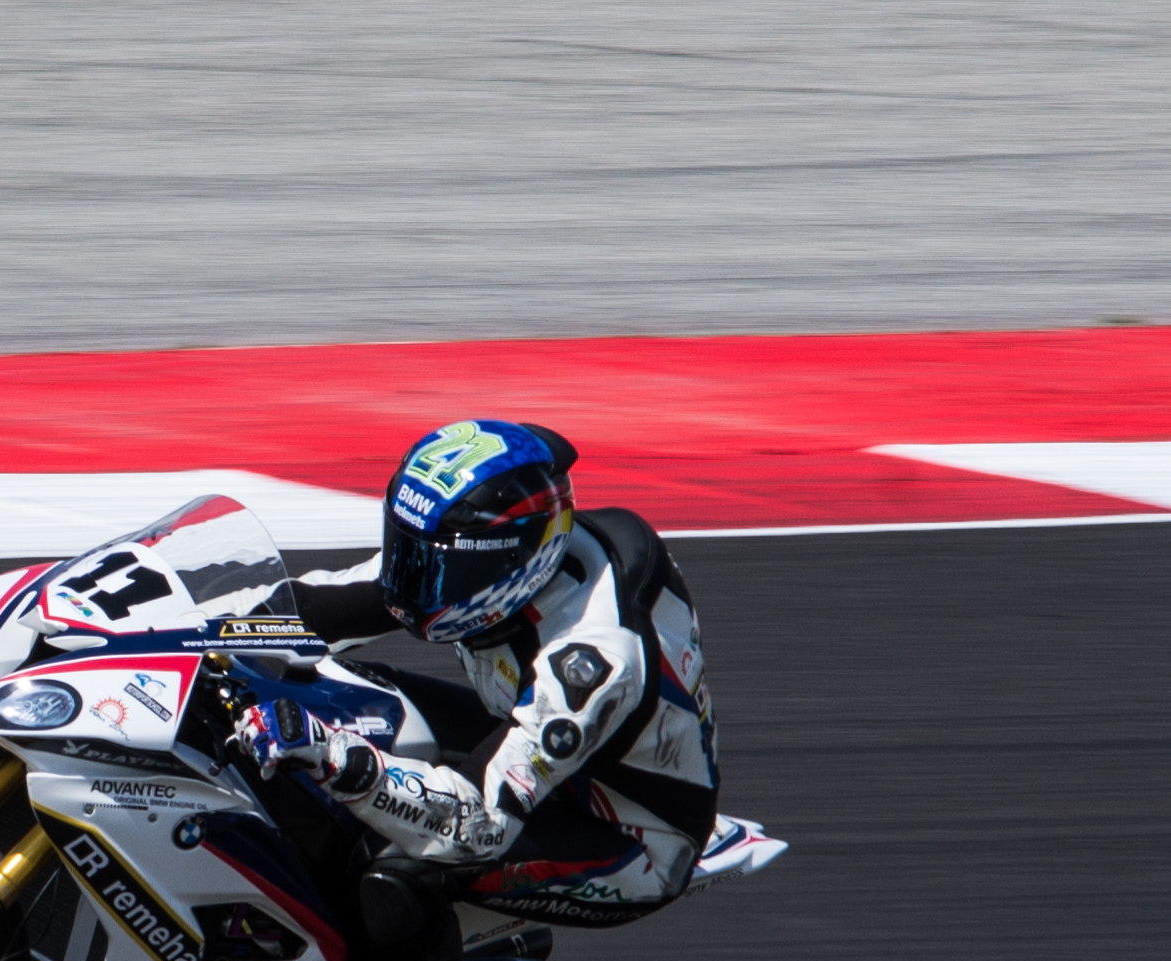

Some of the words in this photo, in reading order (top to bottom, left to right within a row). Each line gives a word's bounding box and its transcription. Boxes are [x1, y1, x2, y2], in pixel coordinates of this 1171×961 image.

[405, 421, 507, 499] 21
[398, 484, 435, 516] BMW
[393, 501, 426, 530] helmets
[59, 551, 173, 621] 11
[255, 622, 305, 633] remeha
[90, 780, 177, 799] ADVANTEC
[113, 796, 148, 805] ORIGINAL
[149, 799, 168, 807] BMW
[169, 801, 196, 809] ENGINE
[372, 791, 425, 824] BMW
